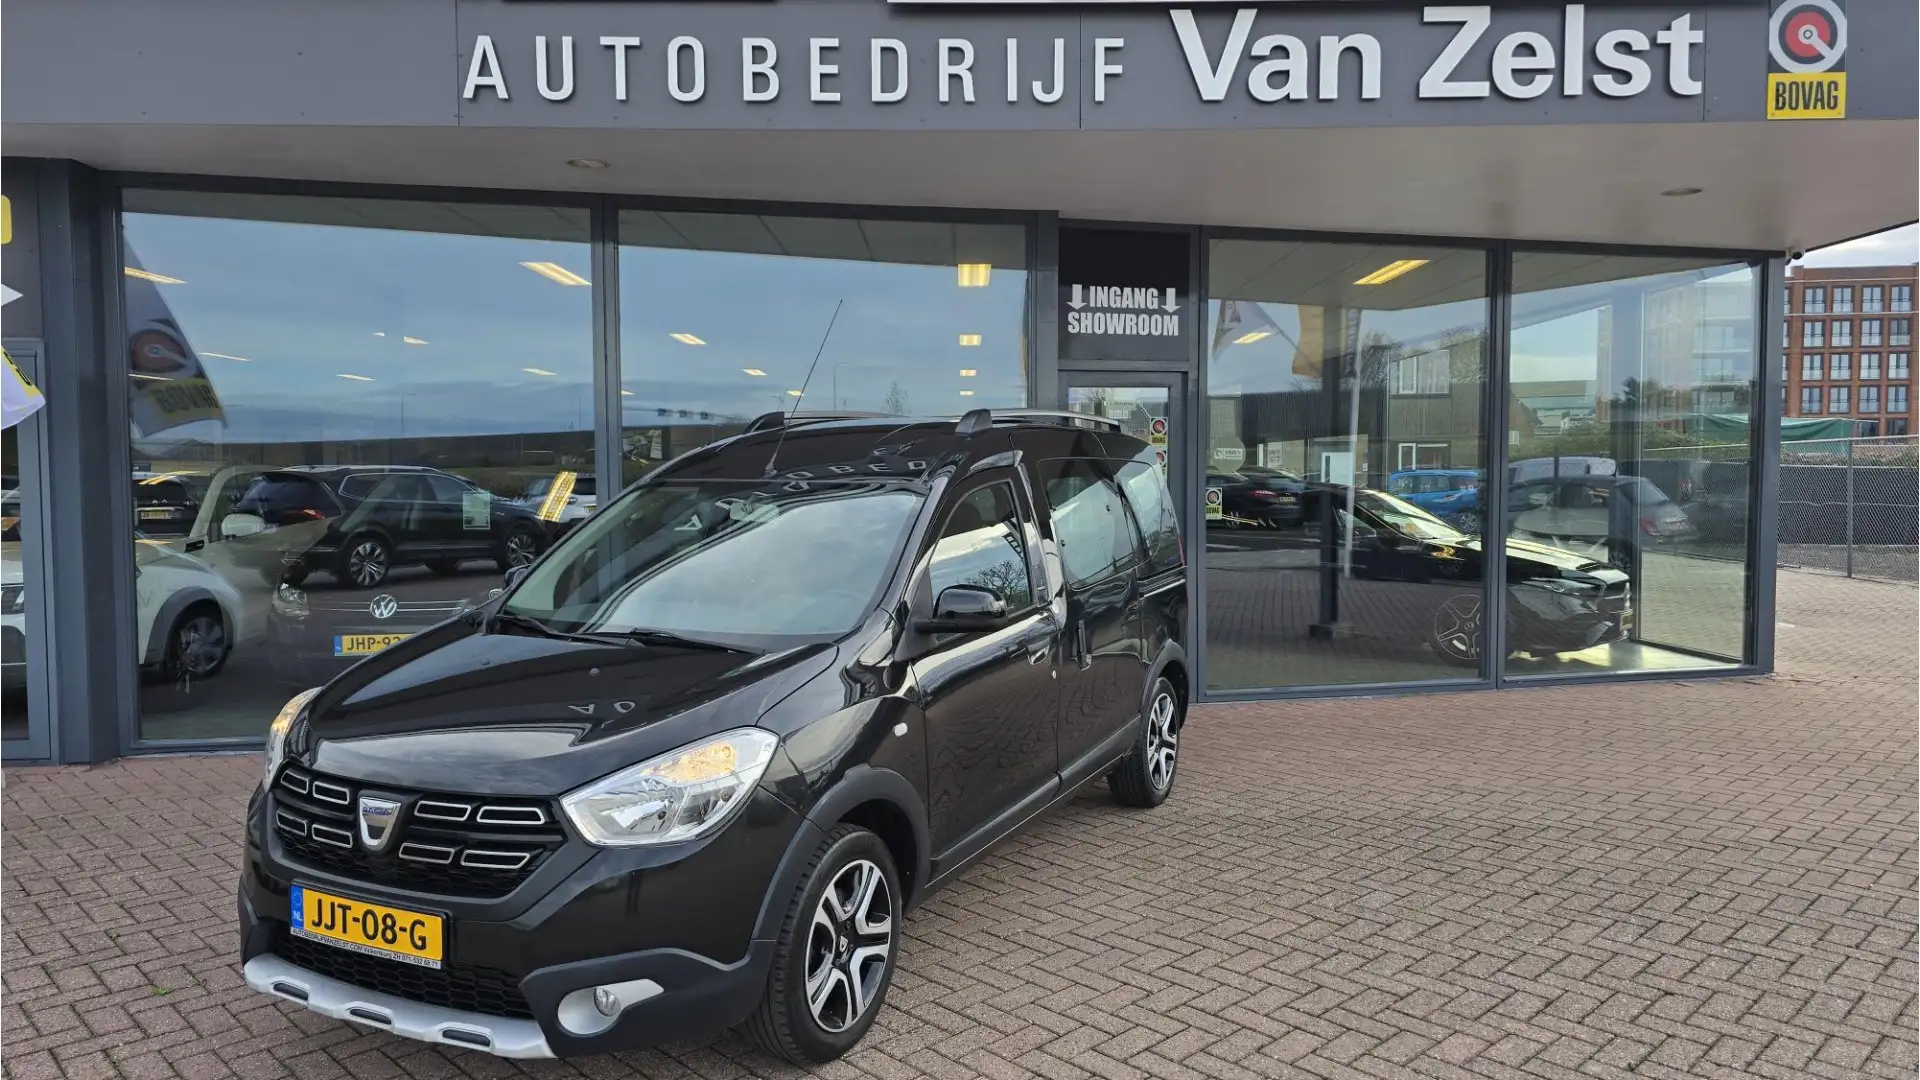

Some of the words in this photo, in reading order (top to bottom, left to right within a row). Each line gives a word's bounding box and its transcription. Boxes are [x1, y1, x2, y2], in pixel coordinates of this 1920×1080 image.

[462, 35, 1124, 103] AUTOBEDRIJF
[1169, 8, 1381, 102] Van
[1419, 4, 1703, 99] Zelst
[1774, 80, 1839, 111] BOVAG
[1089, 285, 1159, 310] INGANG
[1067, 311, 1179, 336] SHOWROOM
[311, 898, 428, 951] JJT-08-G
[392, 953, 401, 961] ZH
